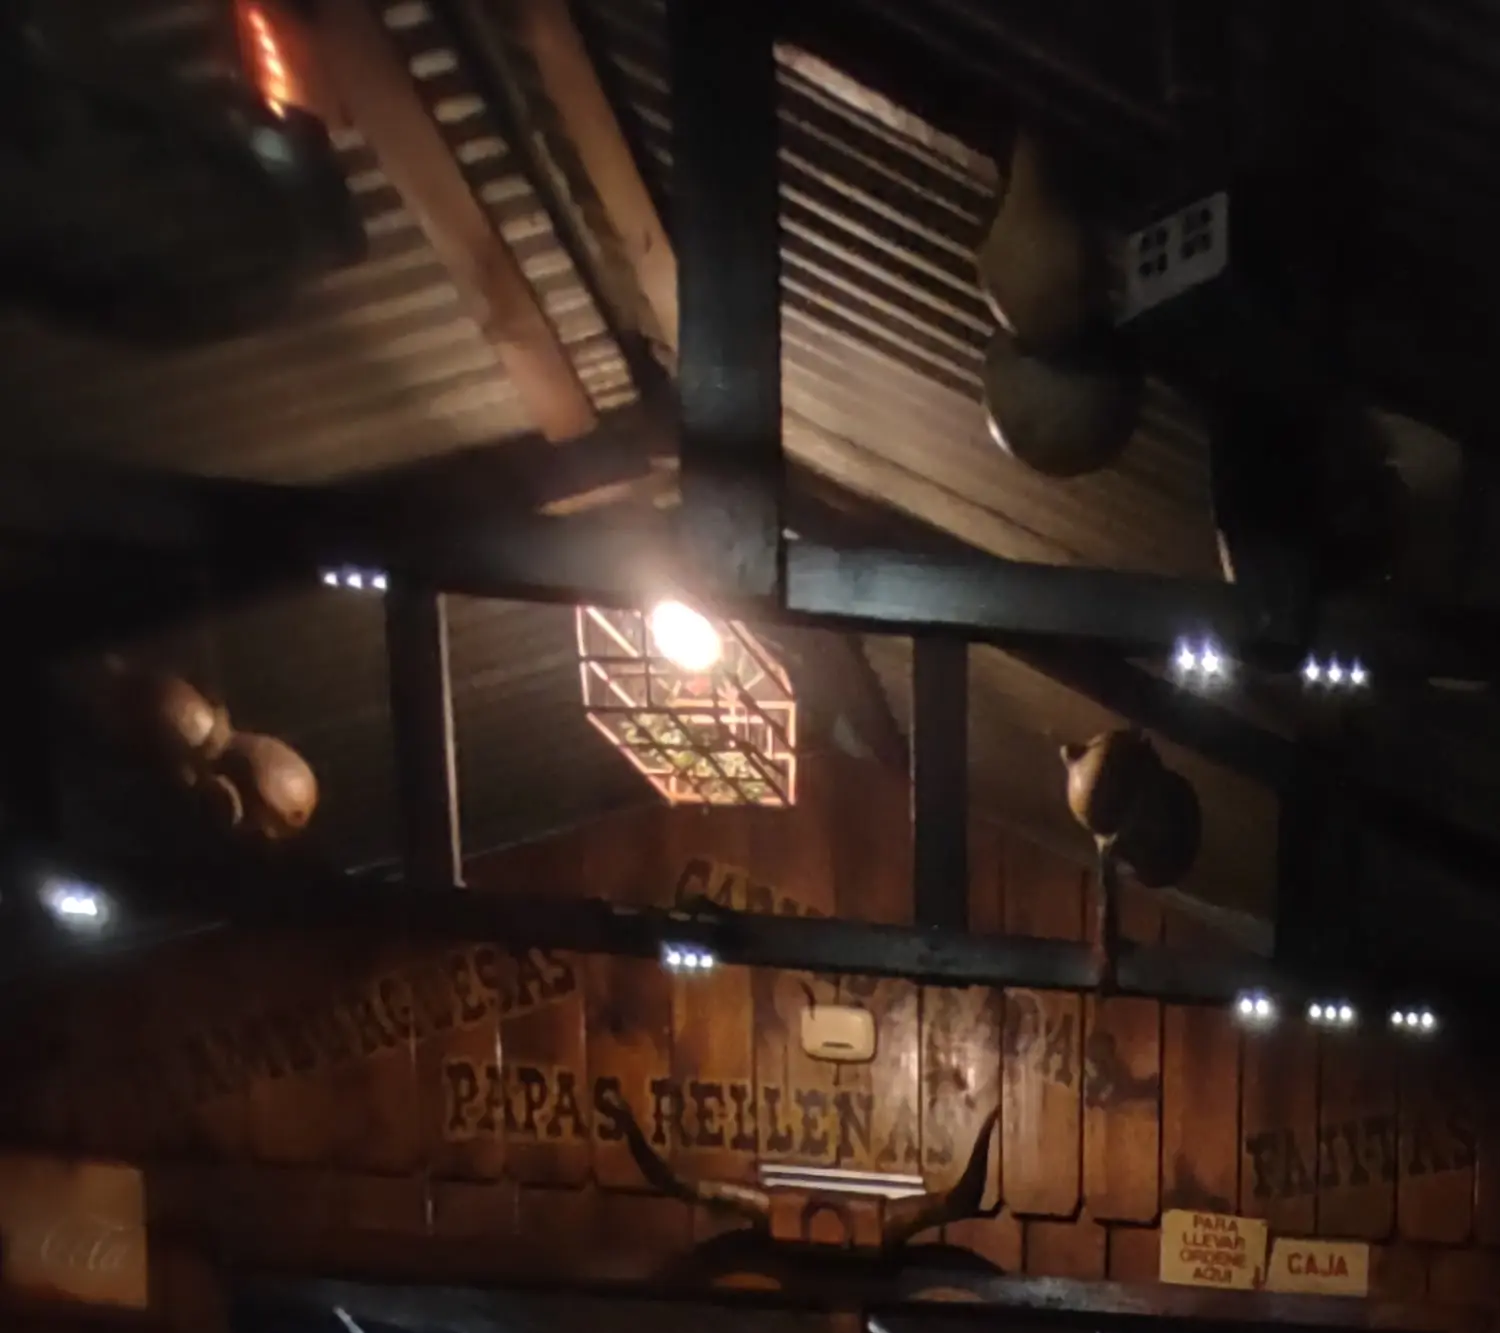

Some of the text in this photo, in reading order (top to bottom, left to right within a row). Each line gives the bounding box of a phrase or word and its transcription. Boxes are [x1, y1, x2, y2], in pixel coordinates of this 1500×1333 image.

[446, 1062, 626, 1140] PAPAS
[1192, 1214, 1239, 1232] PARA
[1182, 1231, 1246, 1250] LLEVAR
[1287, 1252, 1350, 1277] CAJA
[1192, 1267, 1233, 1284] AQUI
